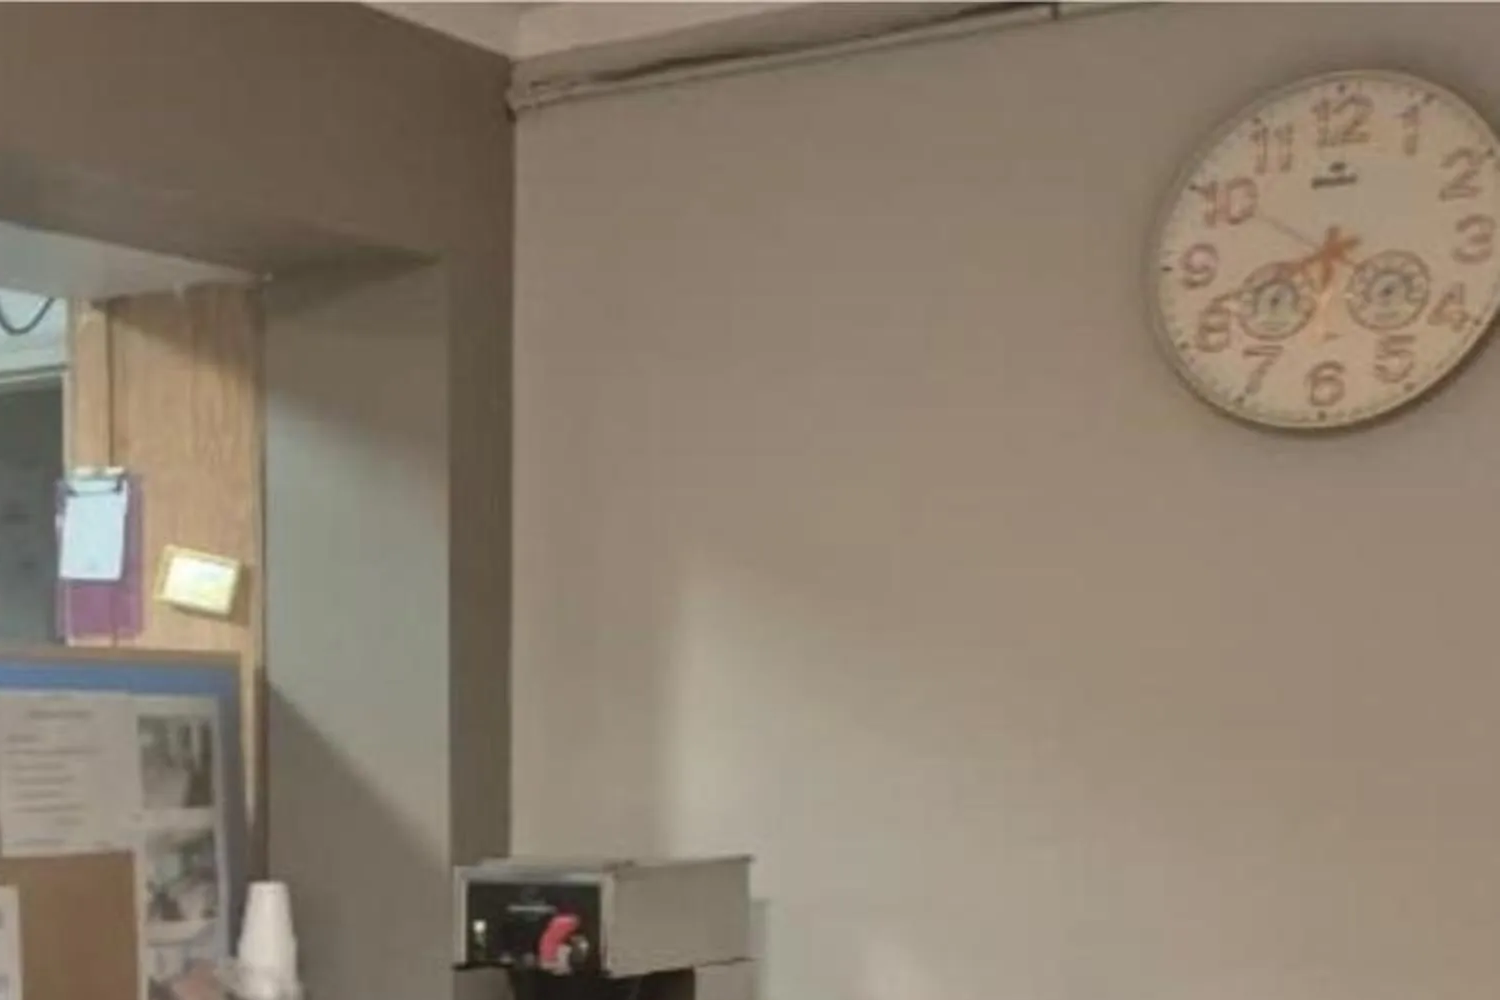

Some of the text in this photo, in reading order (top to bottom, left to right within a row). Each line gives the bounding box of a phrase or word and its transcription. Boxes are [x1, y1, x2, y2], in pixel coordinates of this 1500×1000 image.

[1311, 95, 1374, 148] 12
[1397, 104, 1420, 157] 1
[1251, 124, 1294, 175] 11
[1438, 147, 1486, 202] 2
[1197, 178, 1259, 227] 10
[1452, 212, 1497, 265] 3
[1181, 242, 1220, 290] 9
[1426, 281, 1473, 332] 4
[1242, 344, 1284, 395] 7
[1304, 360, 1347, 408] 6
[1373, 333, 1417, 384] 5
